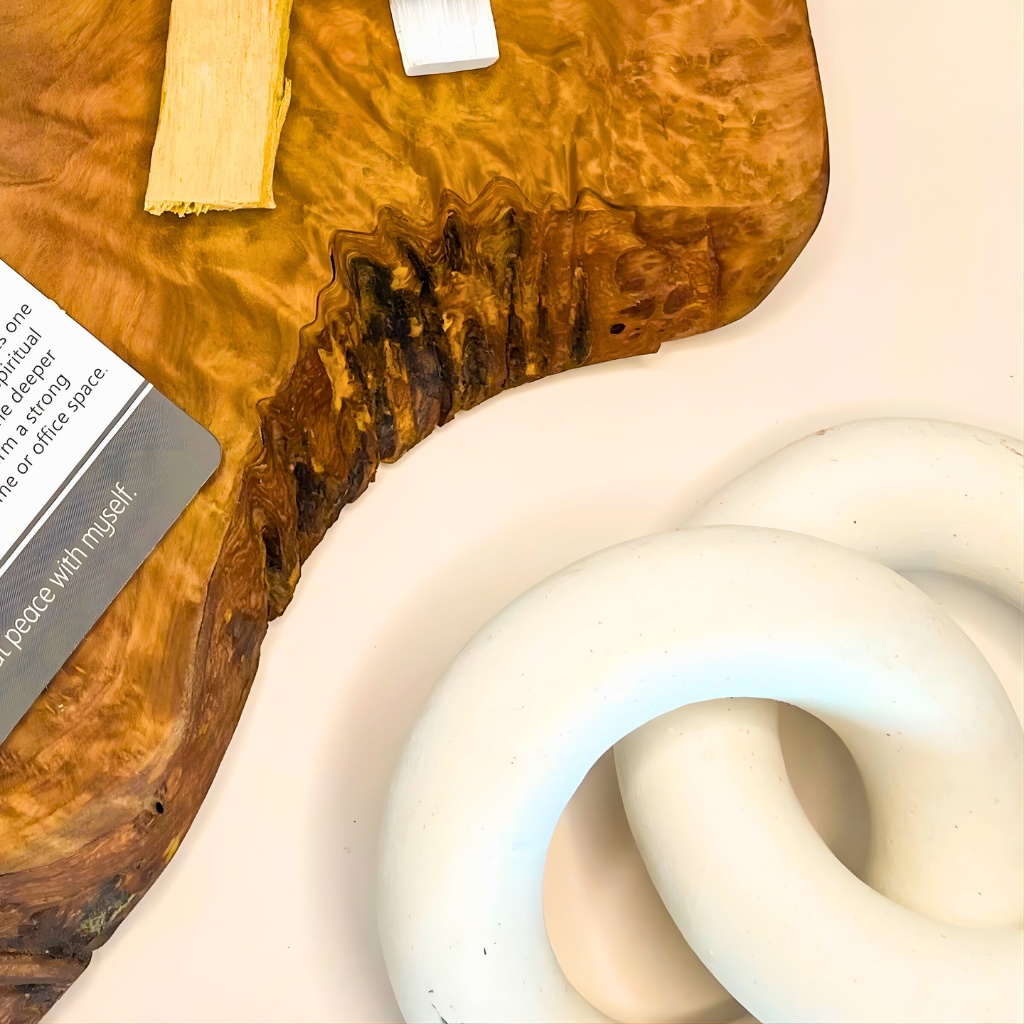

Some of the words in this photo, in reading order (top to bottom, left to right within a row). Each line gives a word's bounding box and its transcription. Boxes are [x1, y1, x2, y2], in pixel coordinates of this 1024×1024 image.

[5, 303, 33, 334] one
[10, 349, 56, 404] deeper
[15, 424, 29, 437] a
[25, 373, 71, 425] strong
[16, 454, 33, 475] or
[32, 412, 70, 455] office
[67, 368, 109, 413] space.
[4, 587, 56, 651] peace
[49, 547, 88, 588] with
[81, 481, 137, 550] myself.
